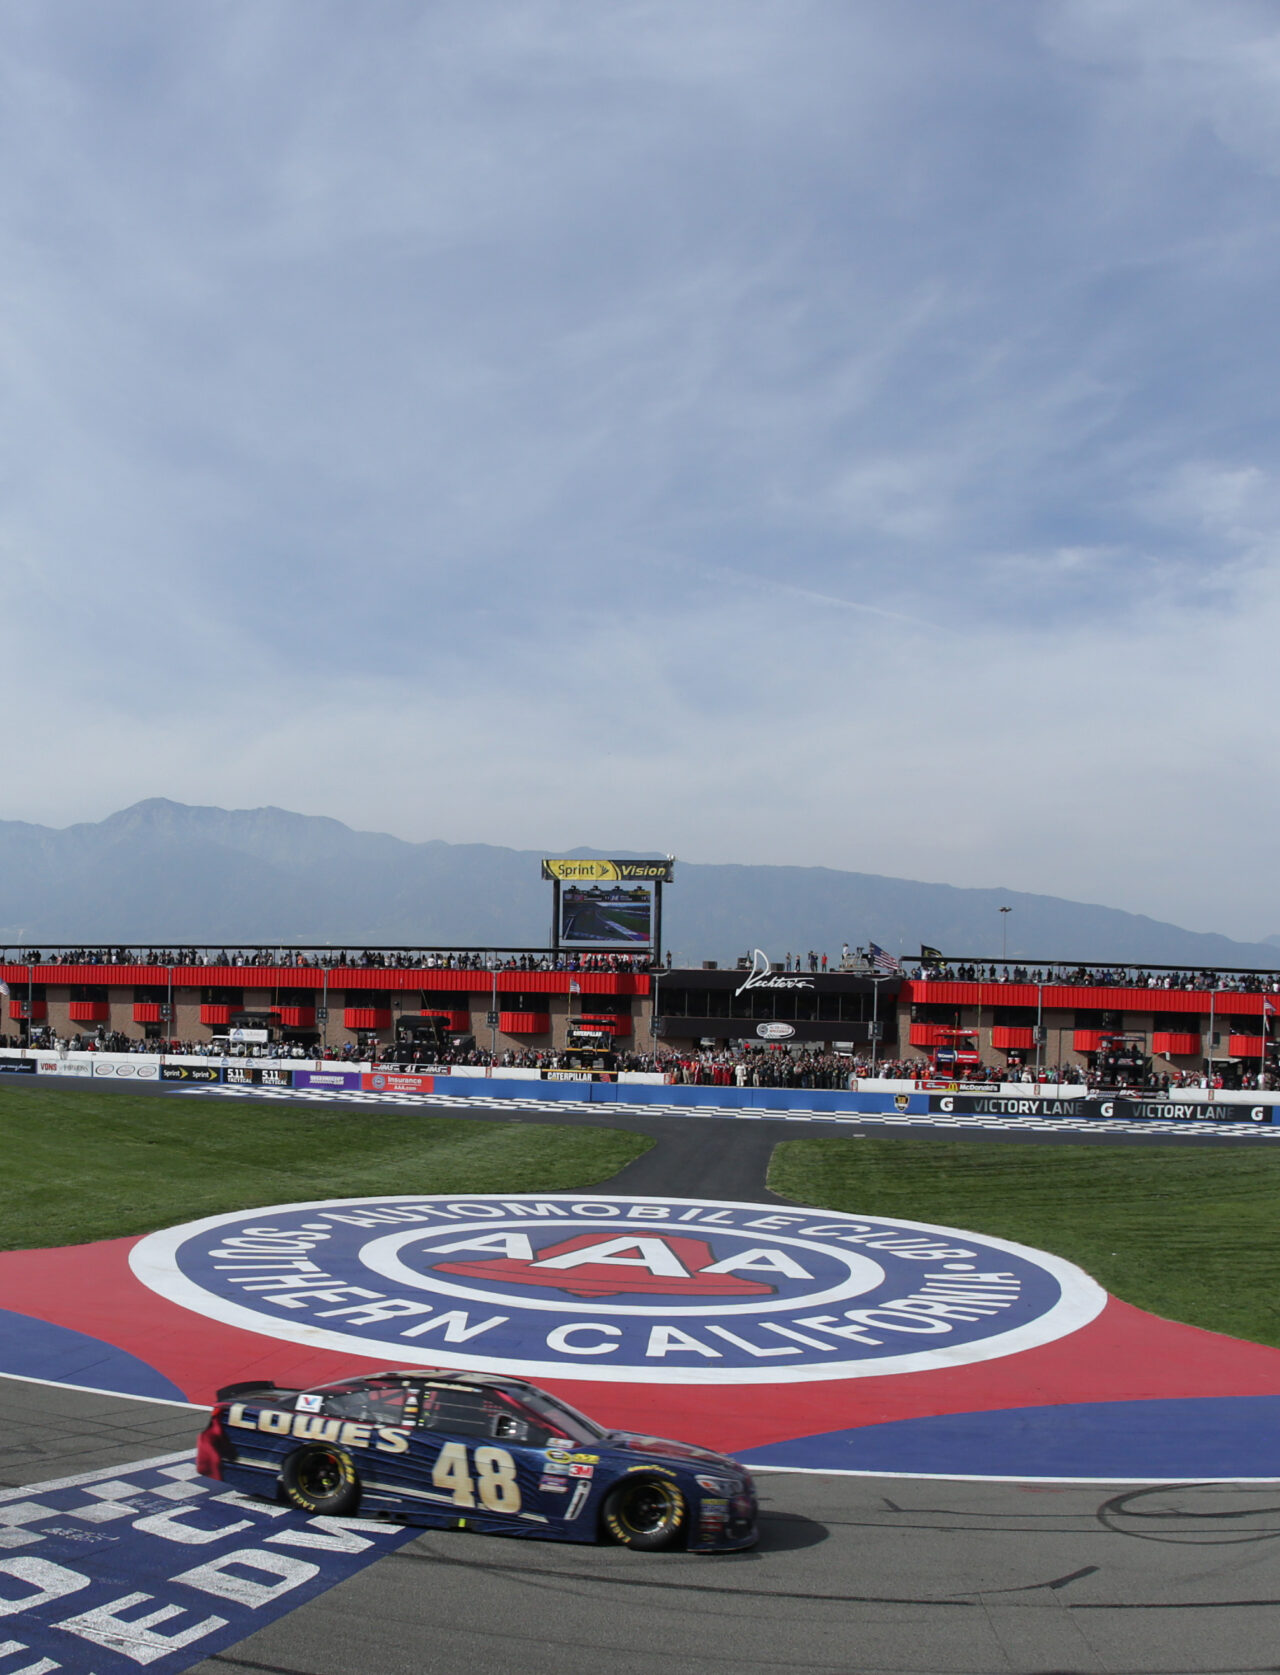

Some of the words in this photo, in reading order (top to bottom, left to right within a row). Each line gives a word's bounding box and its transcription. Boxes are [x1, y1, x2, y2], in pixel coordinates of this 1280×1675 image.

[558, 864, 594, 877] Sprint
[621, 865, 667, 876] Vision
[40, 1063, 57, 1071] VONS
[163, 1069, 181, 1079] Sprint
[192, 1071, 209, 1080] Sprint
[227, 1068, 244, 1078] 5.11
[262, 1070, 279, 1080] 5.11
[547, 1072, 592, 1082] CATERPILLAR
[387, 1076, 422, 1084] Insurance
[959, 1083, 998, 1091] McDonald's
[940, 1097, 953, 1112] G
[973, 1098, 1040, 1114] VICTORY
[1042, 1101, 1084, 1115] LANE
[1100, 1102, 1114, 1117] G
[1132, 1104, 1194, 1119] VICTORY
[1196, 1105, 1234, 1119] LANE
[1251, 1106, 1264, 1121] G
[317, 1202, 807, 1230] AUTOMOBILE
[798, 1223, 978, 1261] CLUB
[422, 1231, 816, 1280] AAA
[207, 1226, 510, 1343] SOUTHERN
[546, 1272, 1021, 1357] CALIFORNIA
[228, 1403, 411, 1453] LOWE'S
[570, 1464, 593, 1478] 3M
[431, 1441, 522, 1513] 48
